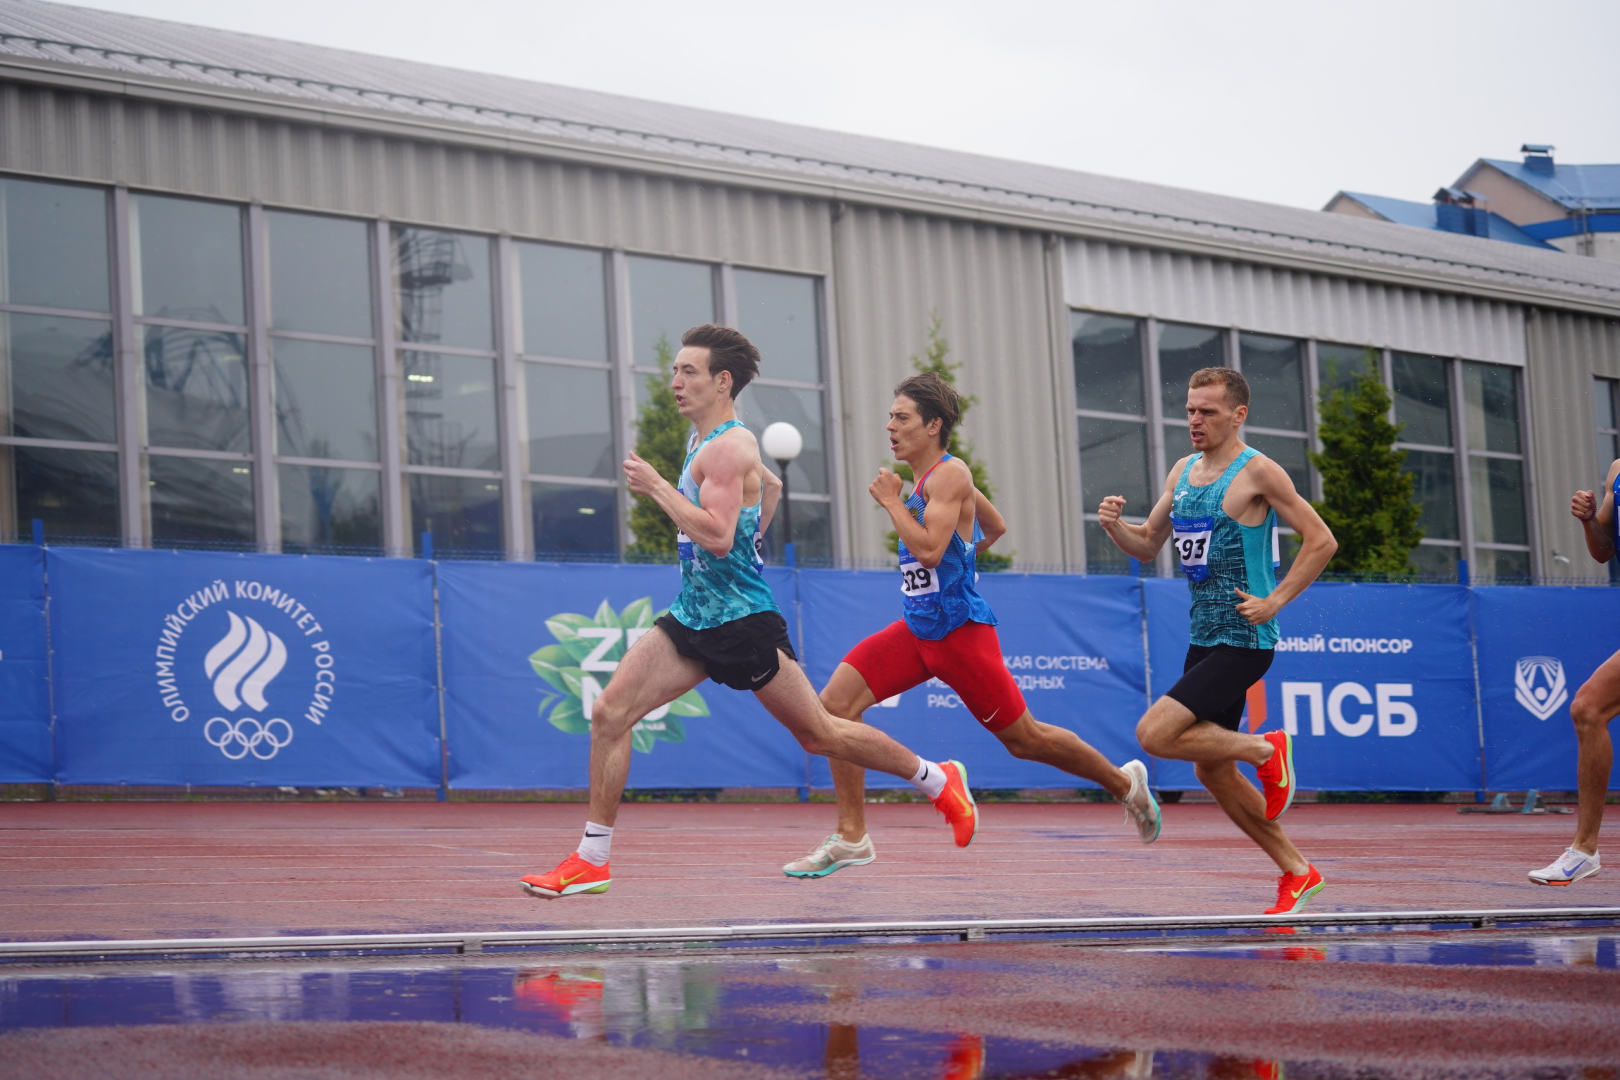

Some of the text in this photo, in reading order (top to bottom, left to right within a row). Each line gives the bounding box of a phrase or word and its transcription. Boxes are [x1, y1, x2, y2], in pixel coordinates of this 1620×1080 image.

[155, 579, 335, 725] ОЛИМПИЙСКИЙ КОМИТЕТ РОССИИ
[1274, 634, 1413, 654] ЬНЫЙ СПОНСОР
[1003, 656, 1110, 671] КАЯ СИСТЕМА
[1281, 681, 1419, 737] ПСБ
